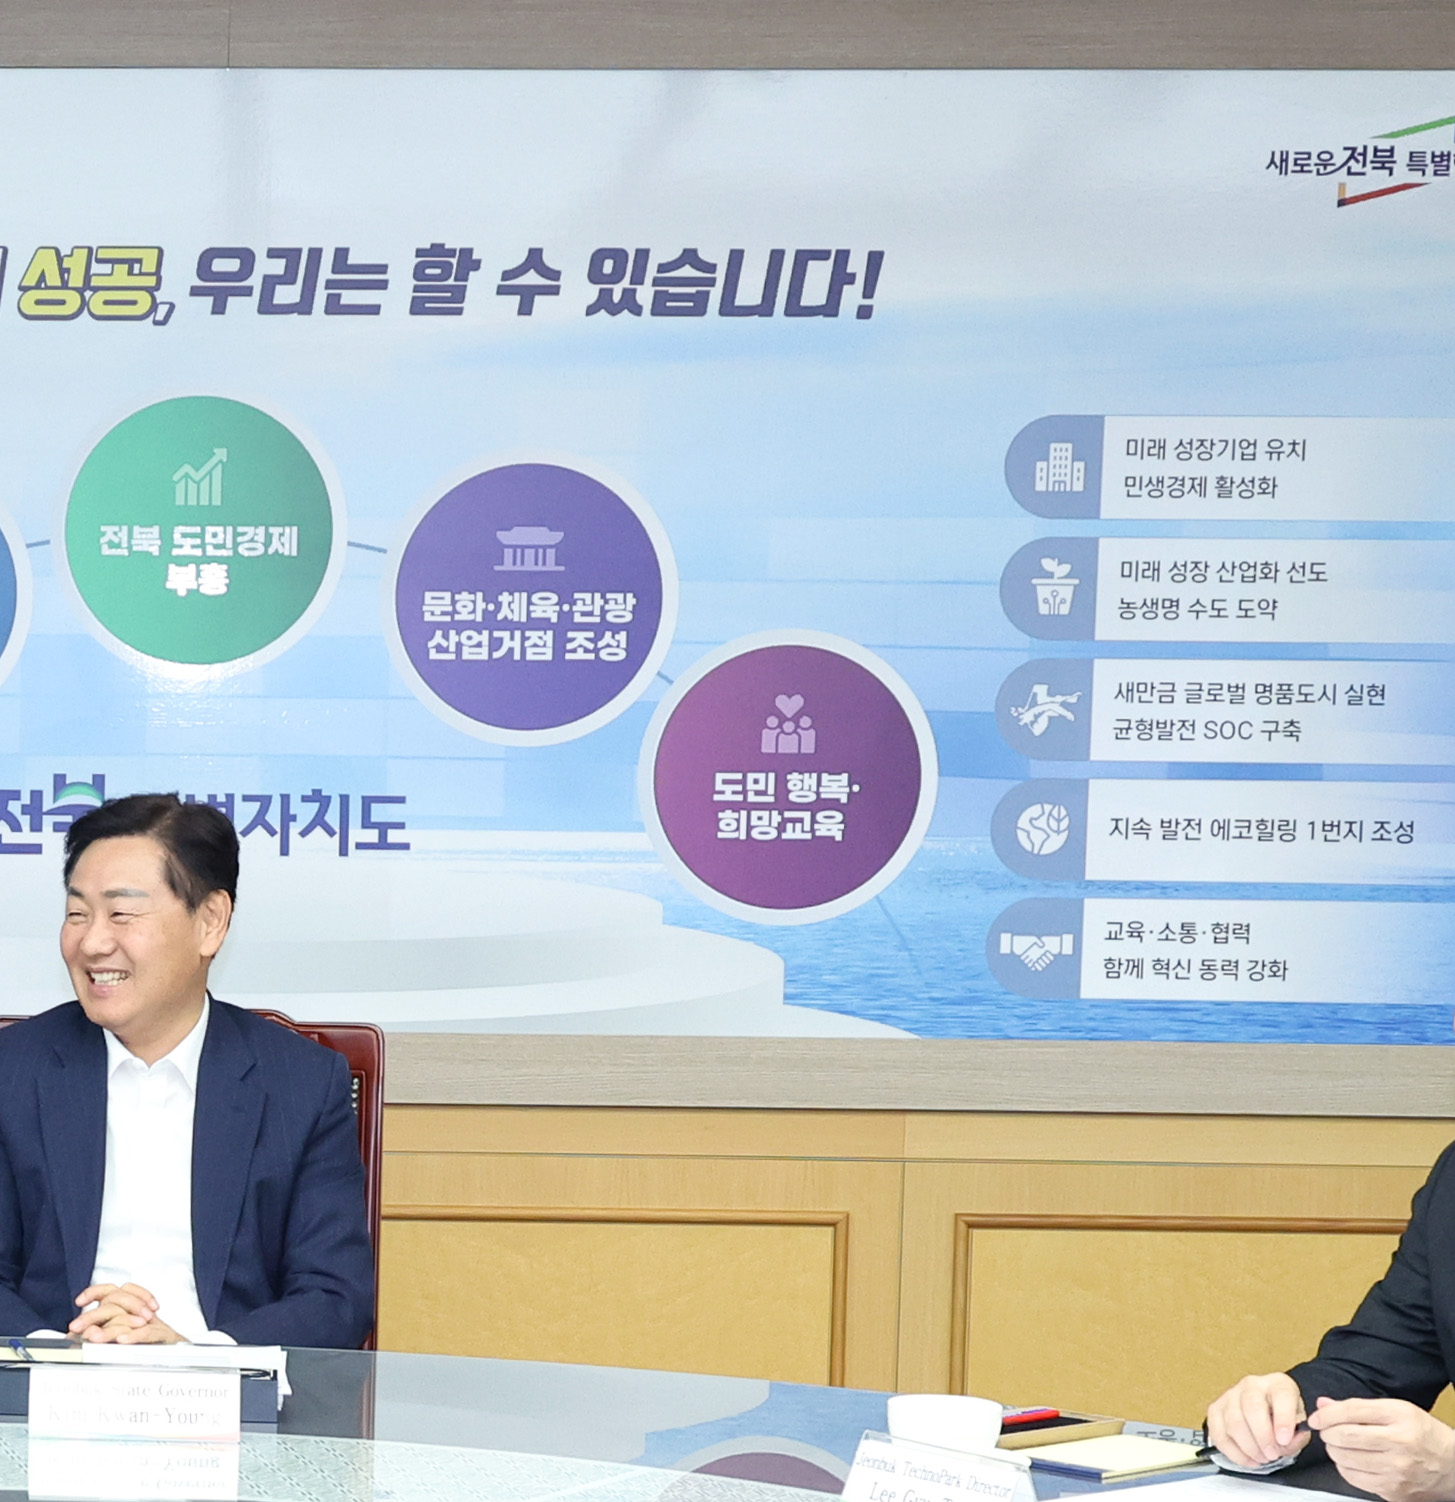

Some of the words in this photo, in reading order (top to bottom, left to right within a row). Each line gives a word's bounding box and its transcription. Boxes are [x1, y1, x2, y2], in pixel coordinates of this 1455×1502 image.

[17, 245, 175, 326] 성공,
[188, 246, 390, 317] 우리는
[408, 242, 483, 317] 할
[495, 246, 562, 317] 수
[585, 246, 885, 321] 있습니다!
[1125, 437, 1167, 461] 미래
[1173, 437, 1257, 461] 성장기업
[1264, 437, 1307, 461] 유치
[1123, 475, 1208, 499] 민생경제
[1214, 475, 1278, 499] 활성화
[99, 524, 161, 557] 전북
[171, 524, 300, 557] 도민경제
[1120, 560, 1161, 583] 미래
[1168, 560, 1210, 583] 성장
[1216, 560, 1280, 584] 산업화
[1286, 560, 1328, 584] 선도
[422, 591, 637, 624] 문화·체육·관광
[1117, 598, 1180, 621] 농생명
[1187, 598, 1229, 621] 수도
[1235, 598, 1278, 621] 도약
[426, 629, 554, 662] 산업거점
[564, 629, 629, 662] 조성
[1113, 681, 1177, 705] 새만금
[1184, 681, 1247, 705] 글로벌
[1253, 681, 1338, 706] 명품도시
[1344, 682, 1386, 707] 실현
[1112, 719, 1197, 742] 균형발전
[1203, 719, 1254, 742] SOC
[1260, 719, 1302, 742] 구축
[712, 772, 777, 804] 도민
[786, 772, 861, 804] 행복·
[717, 808, 845, 842] 희망교육
[1109, 817, 1152, 841] 지속
[1159, 817, 1202, 841] 발전
[1210, 818, 1299, 842] 에코힐링
[1307, 819, 1364, 843] 1번지
[1370, 820, 1415, 845] 조성
[1104, 921, 1251, 945] 교육·소통·협력
[1104, 958, 1145, 981] 함께
[1151, 958, 1191, 981] 혁신
[1198, 958, 1241, 981] 동력
[1246, 958, 1288, 982] 강화
[159, 1383, 230, 1399] Governor
[856, 1452, 896, 1473] Jeonbuk
[903, 1460, 962, 1488] TechnoPark
[966, 1474, 1012, 1499] Director
